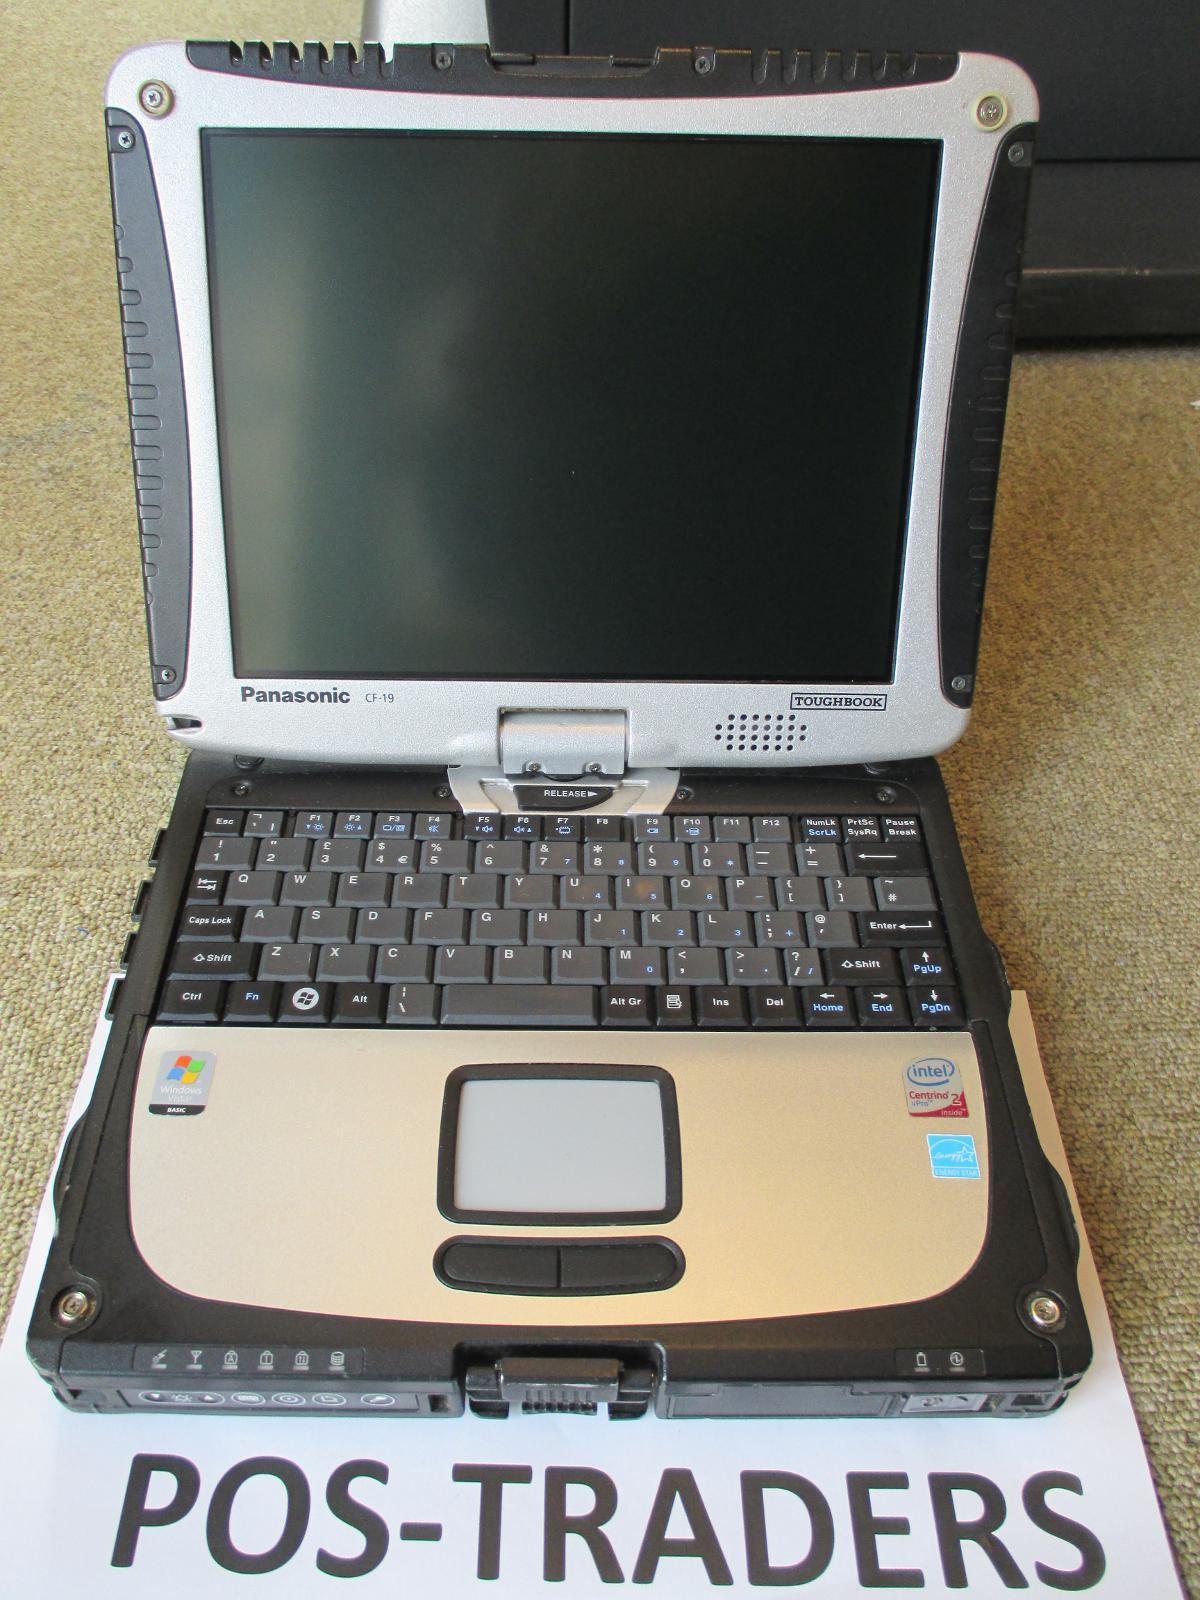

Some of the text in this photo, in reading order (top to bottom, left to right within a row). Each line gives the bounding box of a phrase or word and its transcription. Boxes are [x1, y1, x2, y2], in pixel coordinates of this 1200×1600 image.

[241, 687, 350, 703] Panasonic
[365, 693, 395, 704] CF-19
[795, 696, 882, 707] TOUGHBOOK
[543, 789, 587, 798] RELEASE
[215, 817, 234, 825] Esc
[348, 814, 361, 822] F2
[388, 815, 401, 823] F3
[517, 816, 529, 824] F6
[596, 817, 609, 825] F8
[806, 818, 836, 826] NumLk
[847, 818, 875, 826] PrtSc
[885, 818, 915, 826] Pause
[808, 828, 837, 836] ScrLk
[847, 828, 878, 837] SysRq
[888, 828, 917, 836] Break
[323, 841, 332, 850] £
[377, 842, 386, 851] $
[430, 842, 442, 852] %
[539, 843, 550, 853] &
[213, 852, 220, 862] 1
[266, 853, 276, 862] 2
[320, 854, 330, 863] 3
[375, 854, 385, 864] 4
[397, 855, 409, 864] €
[429, 855, 439, 865] 5
[484, 856, 493, 866] 6
[539, 856, 548, 866] 7
[593, 857, 602, 866] 8
[648, 857, 657, 867] 9
[702, 858, 712, 868] 0
[238, 873, 249, 883] Q
[293, 874, 307, 884] W
[348, 875, 359, 884] E
[404, 876, 414, 885] R
[459, 876, 468, 886] T
[514, 877, 524, 886] Y
[570, 877, 580, 887] U
[680, 878, 691, 888] O
[735, 879, 745, 888] P
[887, 893, 897, 902] #
[254, 909, 265, 919] A
[311, 910, 321, 920] S
[368, 911, 379, 921] D
[424, 911, 433, 921] F
[481, 912, 492, 922] G
[538, 912, 548, 922] H
[593, 913, 602, 923] J
[651, 913, 662, 923] K
[708, 914, 717, 924] L
[814, 914, 826, 924] @
[188, 916, 232, 926] Caps Lock
[869, 921, 897, 930] Enter
[271, 946, 282, 956] Z
[329, 947, 341, 957] X
[387, 947, 399, 958] C
[445, 948, 456, 959] V
[504, 949, 514, 959] B
[562, 949, 572, 959] N
[620, 949, 632, 960] M
[791, 951, 800, 961] ?
[206, 954, 232, 962] Shift
[854, 960, 881, 968] Shift
[913, 964, 942, 974] PgUp
[182, 992, 202, 1001] Ctrl
[245, 992, 259, 1001] Fn
[351, 995, 368, 1003] Alt
[610, 997, 642, 1006] Alt Gr
[712, 998, 730, 1006] Ins
[766, 998, 784, 1006] Del
[812, 1003, 844, 1012] Home
[871, 1003, 893, 1012] End
[921, 1003, 951, 1014] PgDn
[911, 1064, 948, 1077] intel
[909, 1091, 962, 1106] Centrino 2
[111, 1454, 1106, 1591] POS-TRADERS
